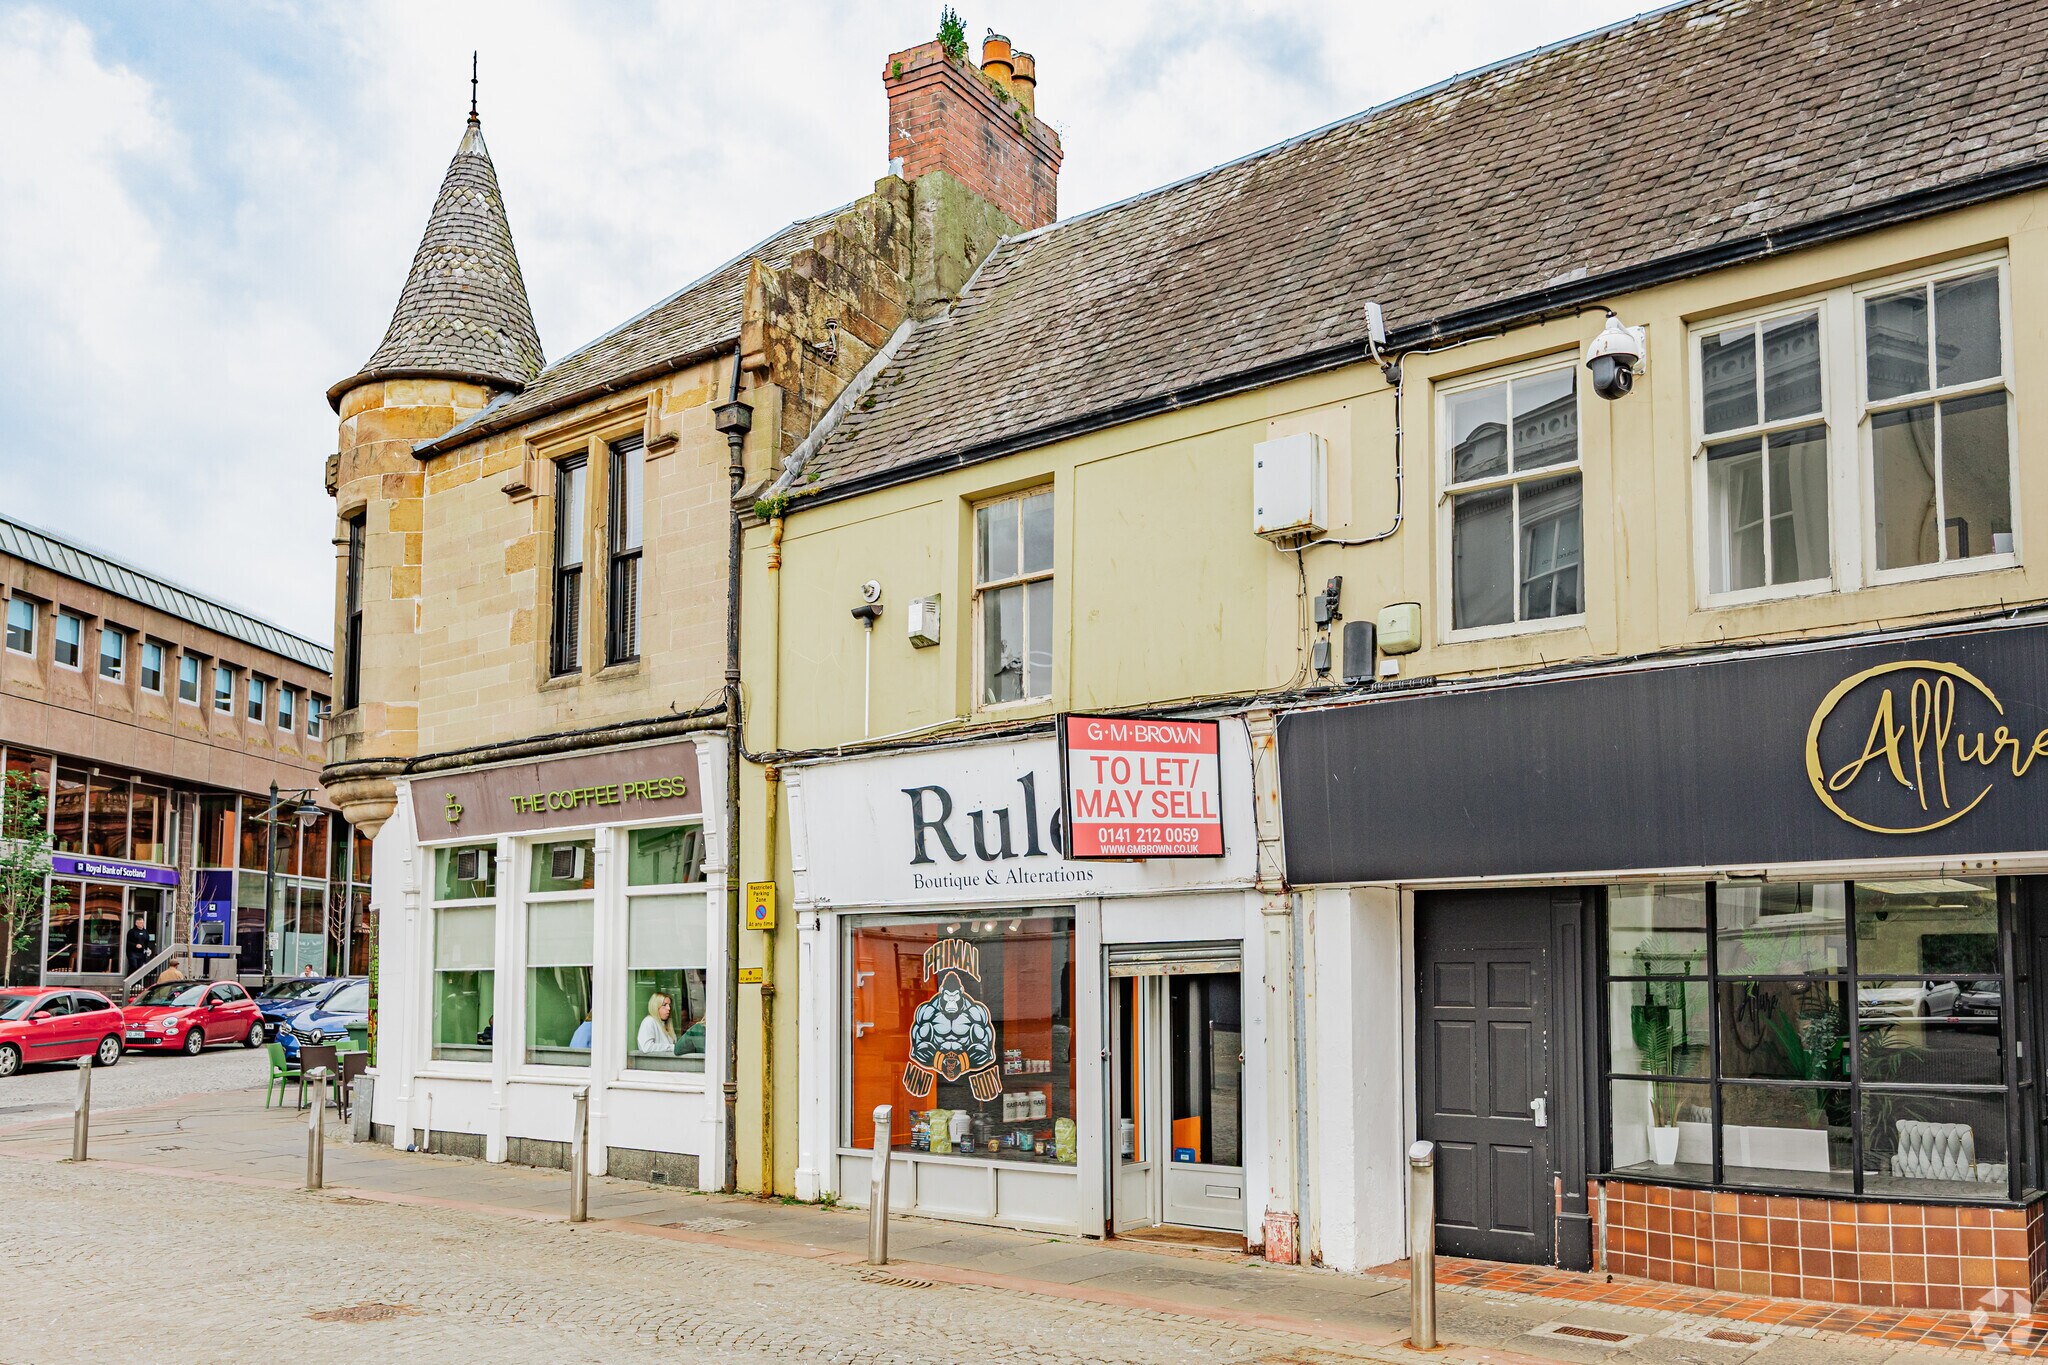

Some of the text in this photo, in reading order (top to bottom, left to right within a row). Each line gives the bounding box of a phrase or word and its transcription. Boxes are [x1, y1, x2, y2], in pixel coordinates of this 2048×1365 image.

[1829, 676, 2048, 810] Allure
[1090, 756, 1199, 788] TO LET/
[509, 776, 687, 813] THE COFFEE PRESS
[1076, 789, 1217, 819] MAY SELL
[1098, 828, 1199, 844] 0141 212 0059
[1100, 844, 1199, 854] WWW.GMBROWN.CO.UK
[86, 863, 146, 878] Royal Bank of Scotland
[914, 867, 1094, 890] Boutique & Alterations
[924, 939, 981, 982] PRIMAL
[902, 1061, 1003, 1101] MIND BODY
